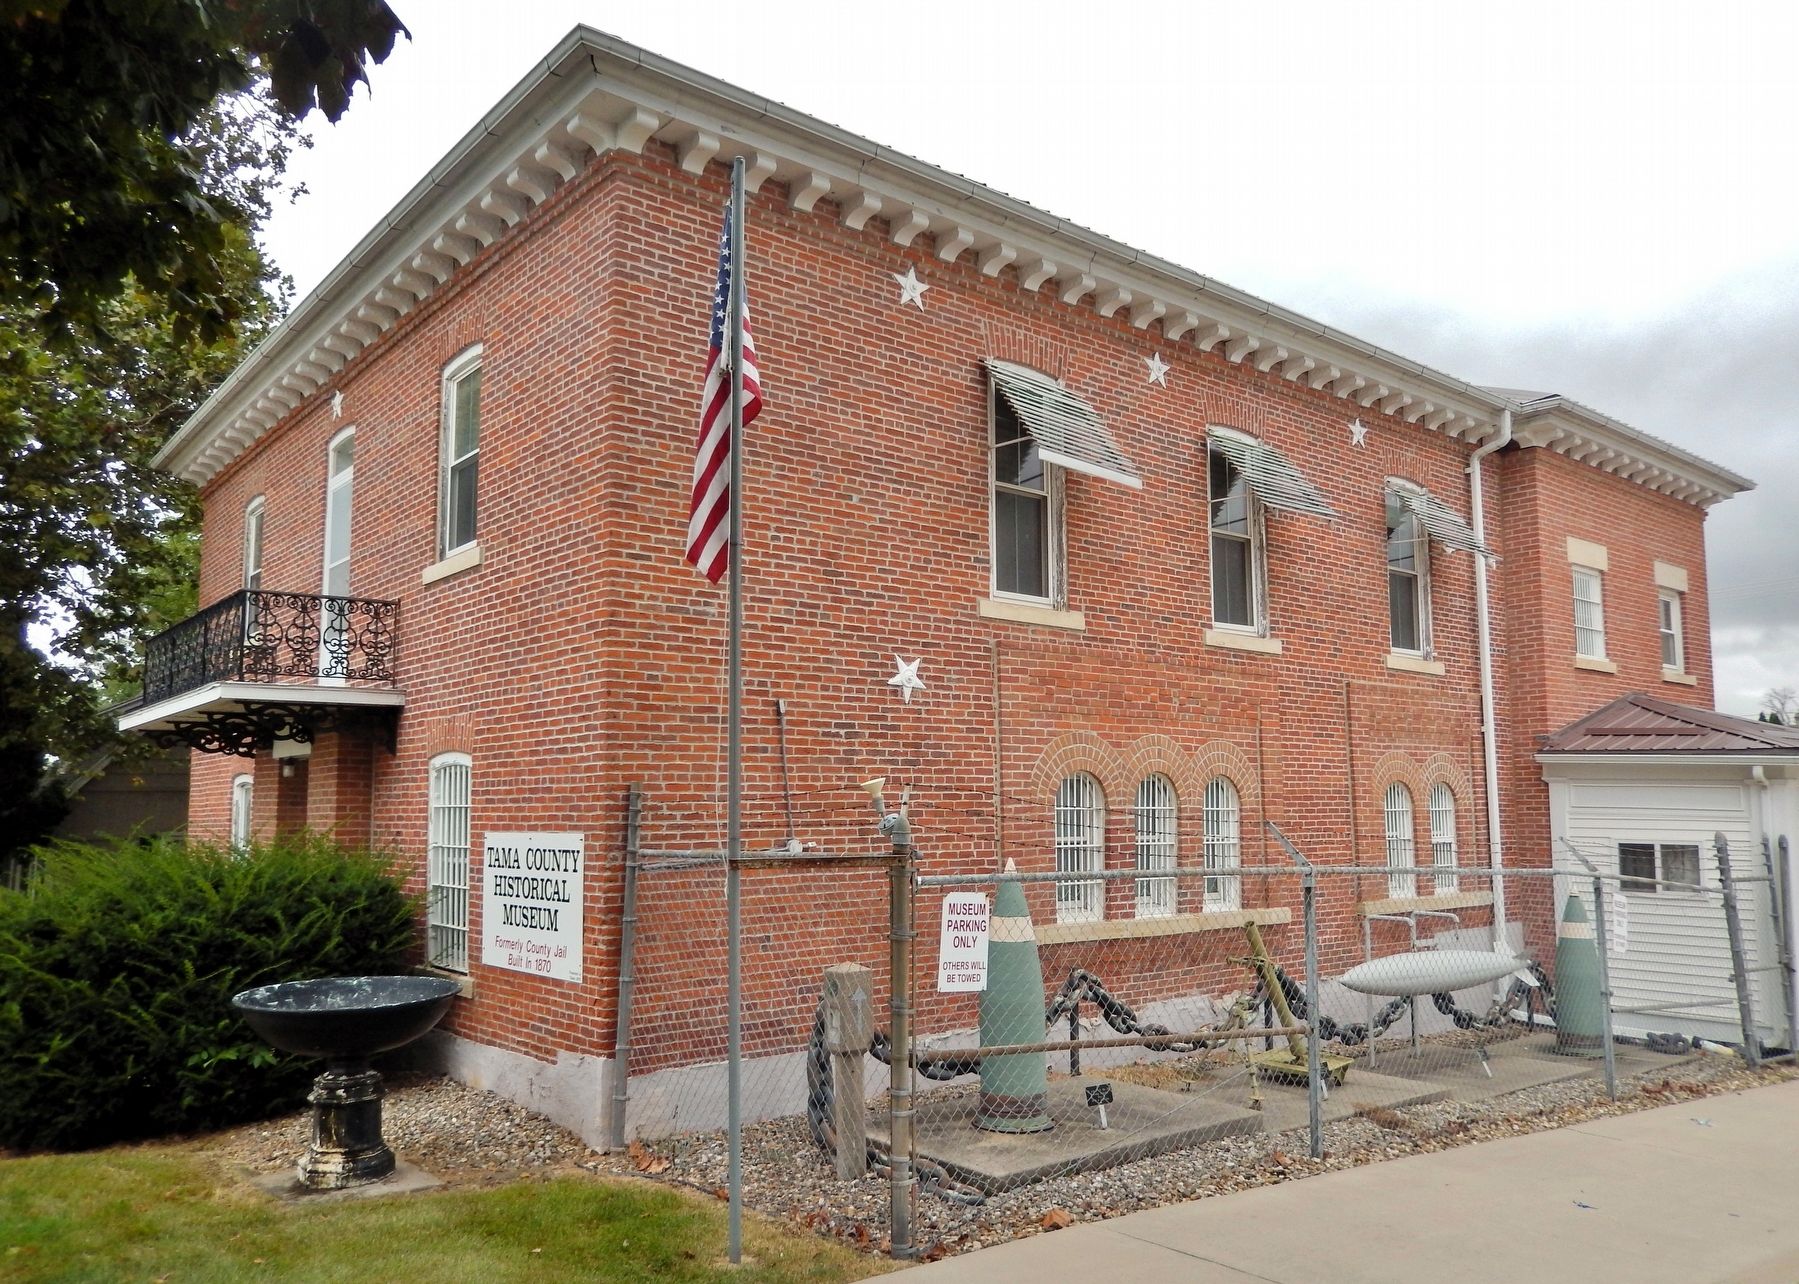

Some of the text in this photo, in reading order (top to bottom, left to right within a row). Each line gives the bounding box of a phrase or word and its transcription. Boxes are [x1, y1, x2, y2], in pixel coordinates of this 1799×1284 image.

[487, 847, 580, 873] TAMA COUNTY
[494, 875, 570, 903] HISTORICAL
[948, 903, 986, 915] MUSEUM
[503, 903, 559, 932] MUSEUM
[947, 919, 987, 932] PARKING
[495, 935, 568, 958] Formerly County Jail
[953, 935, 978, 948] ONLY
[508, 953, 523, 968] Built
[535, 959, 552, 973] 1870
[942, 961, 987, 971] OTHERS WILL
[946, 973, 982, 983] BE TOWED
